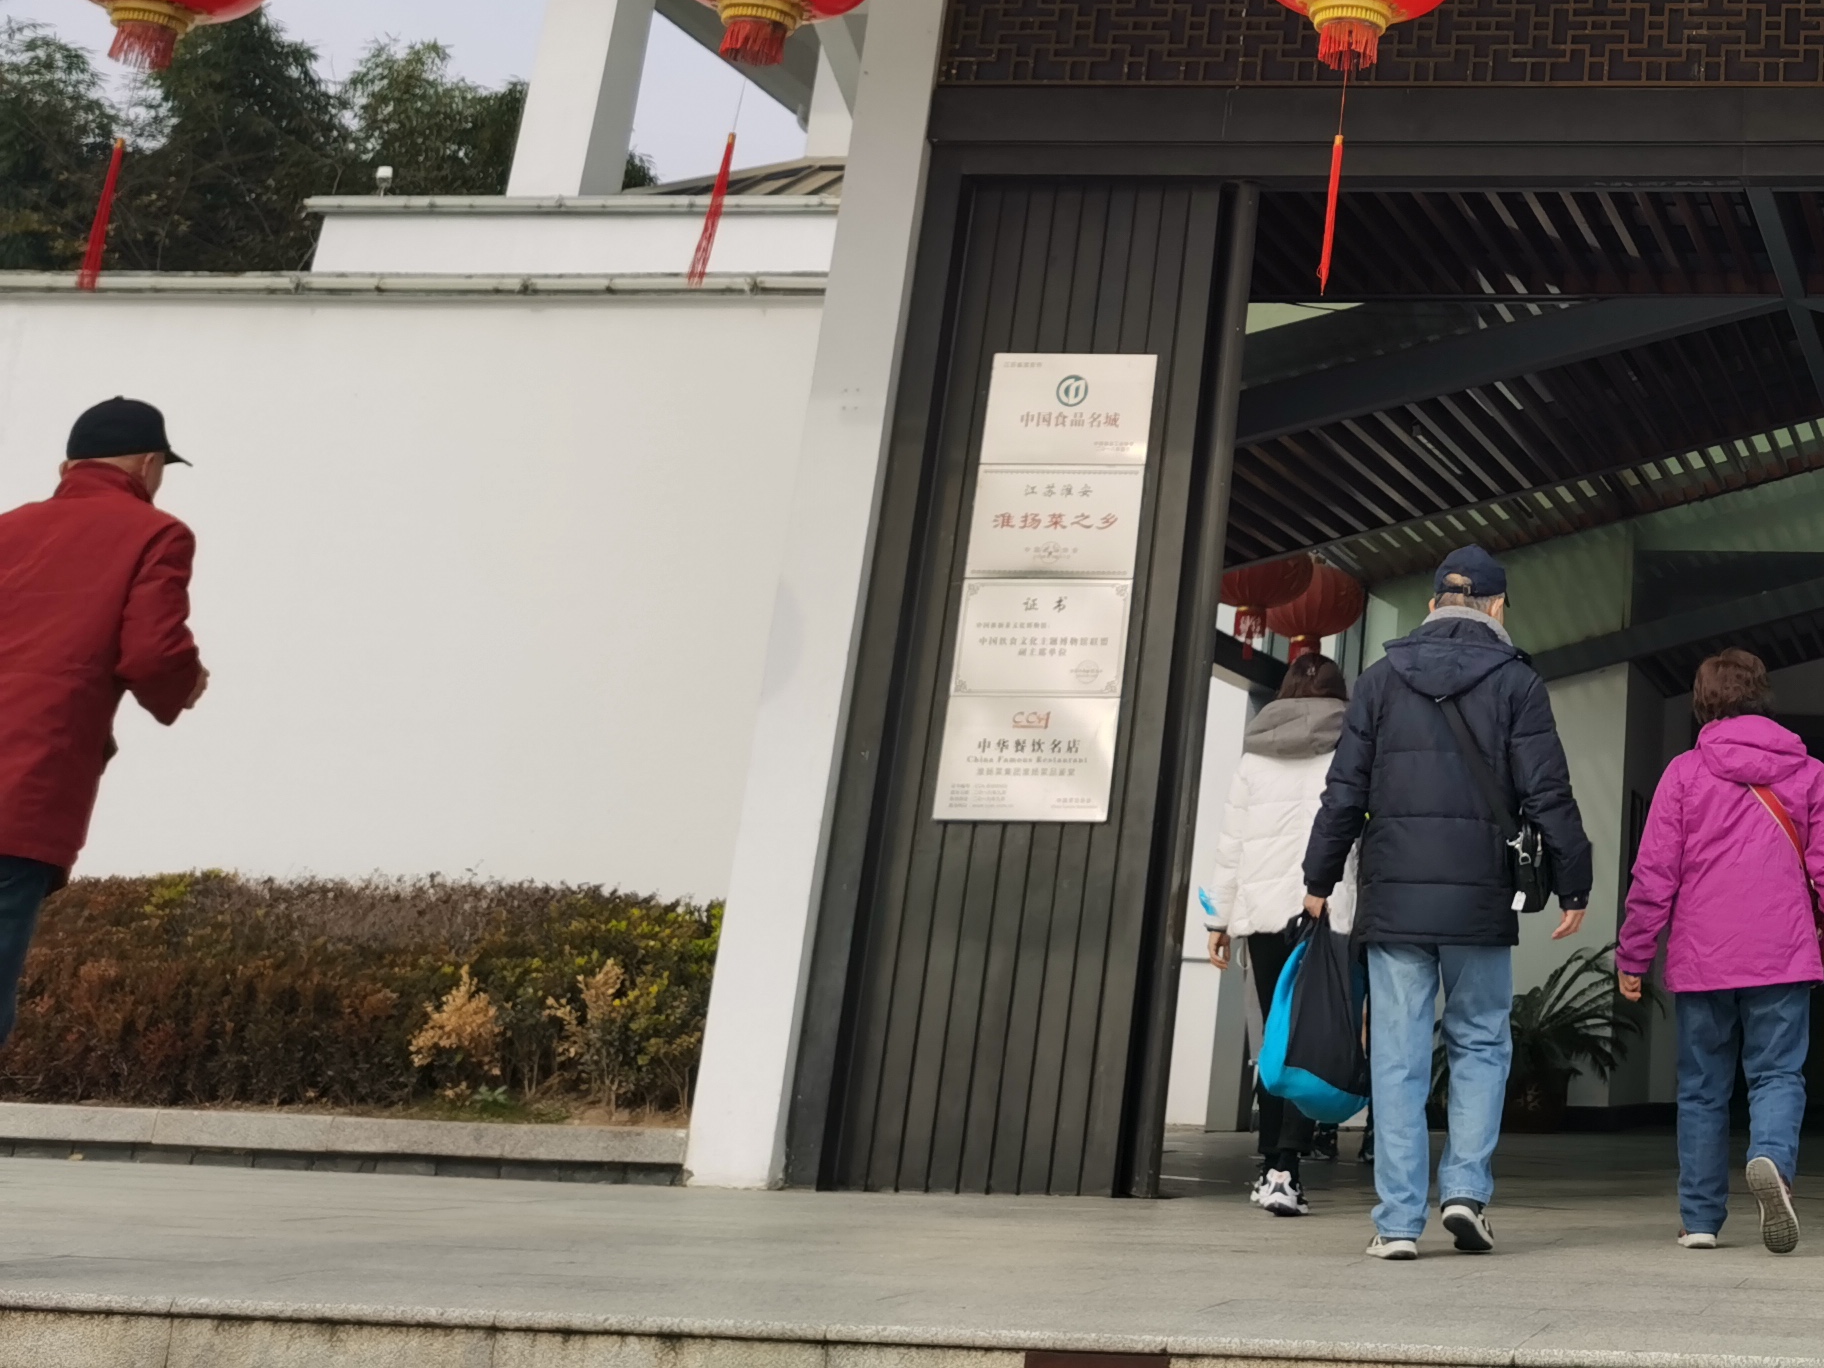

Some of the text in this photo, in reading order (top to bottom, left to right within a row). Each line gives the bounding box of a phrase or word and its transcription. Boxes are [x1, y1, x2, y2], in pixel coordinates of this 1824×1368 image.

[1020, 411, 1121, 429] 中国食品名城
[1024, 483, 1094, 498] 江苏淮安
[992, 512, 1120, 531] 淮扬菜之乡
[977, 738, 1082, 754] 中华餐饮名店
[966, 755, 1088, 764] China Famous Restaurant
